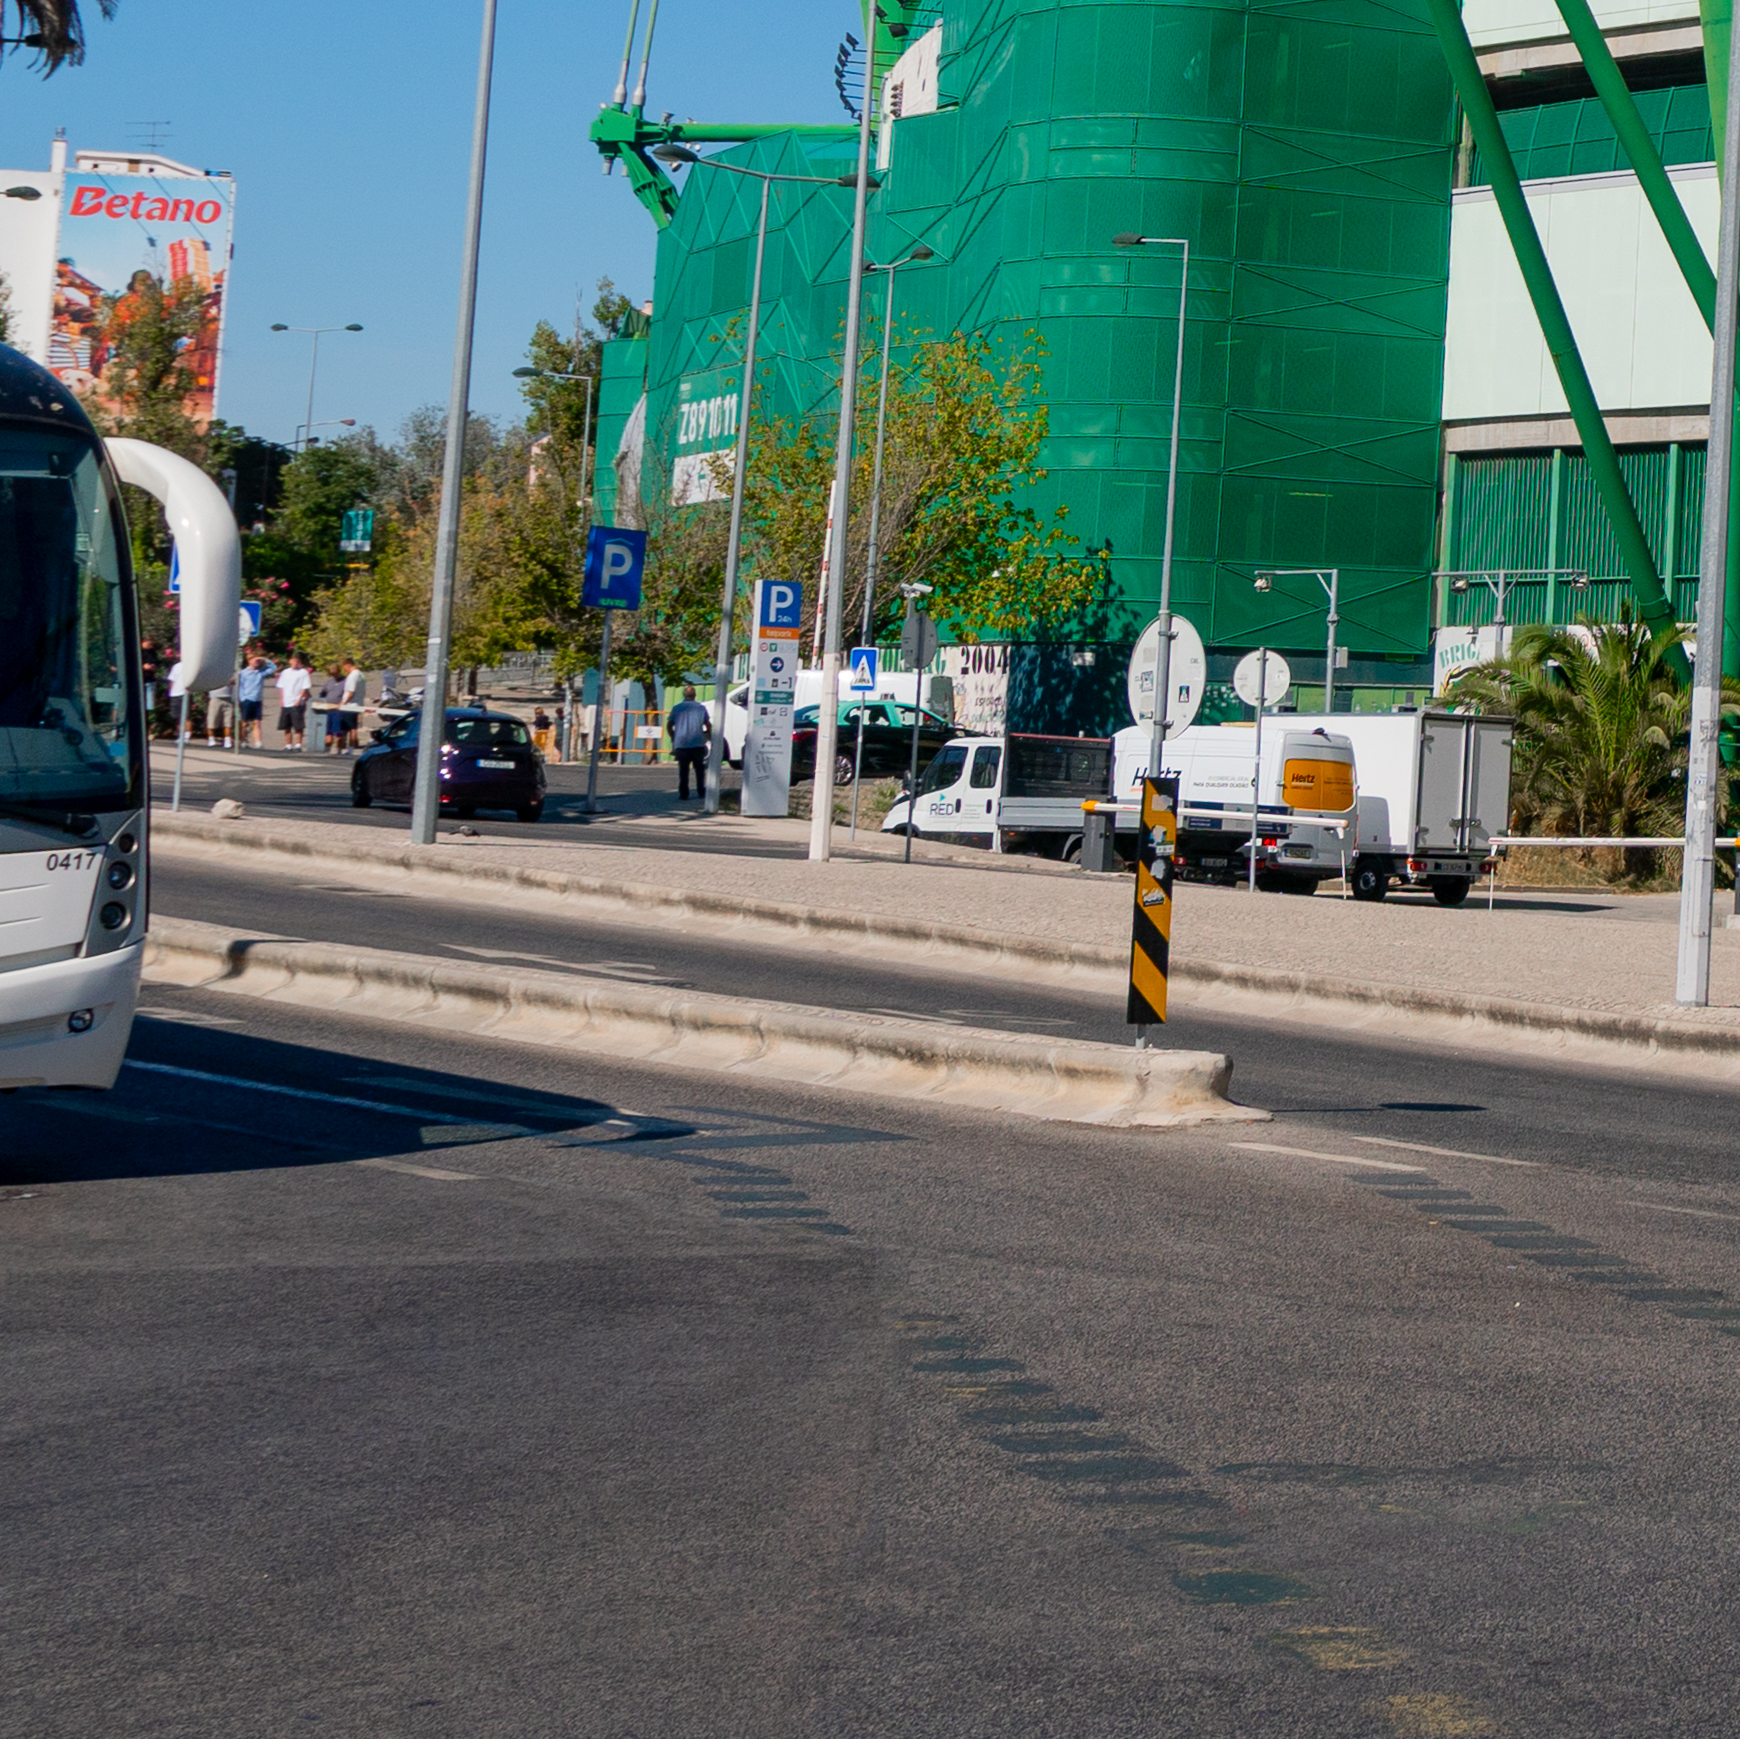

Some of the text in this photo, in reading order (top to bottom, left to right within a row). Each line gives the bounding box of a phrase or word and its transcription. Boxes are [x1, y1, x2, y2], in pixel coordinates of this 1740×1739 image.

[69, 186, 222, 224] Betano
[601, 544, 633, 589] P
[769, 585, 794, 623] P
[1291, 773, 1315, 784] Hertz
[929, 803, 954, 816] RED
[46, 852, 98, 871] 0417
